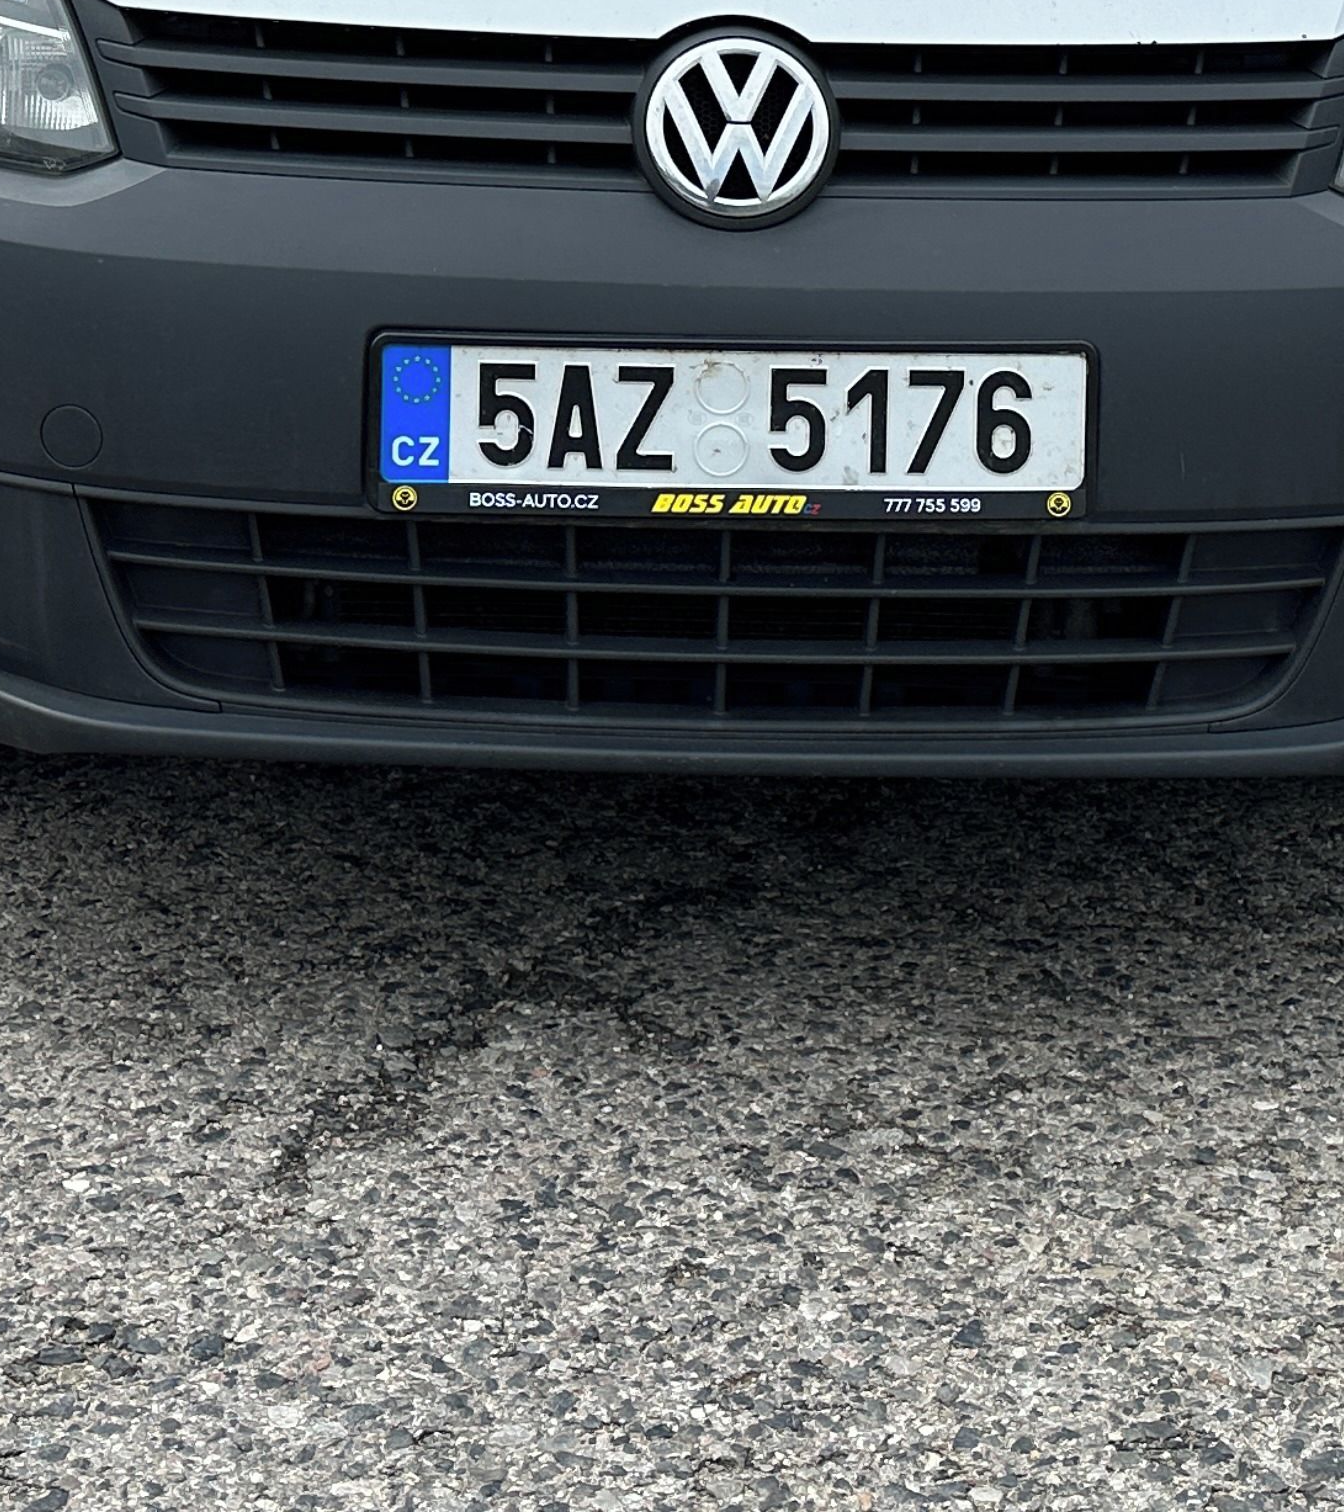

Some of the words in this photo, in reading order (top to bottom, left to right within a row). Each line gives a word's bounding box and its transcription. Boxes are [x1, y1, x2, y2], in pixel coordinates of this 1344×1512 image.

[477, 361, 677, 473] 5AZ
[767, 367, 1032, 476] 5176
[391, 435, 440, 467] CZ
[469, 492, 599, 509] BOSS-AUTO.CZ
[651, 493, 727, 515] BOSS
[884, 498, 915, 513] 777
[917, 499, 946, 514] 755
[948, 499, 981, 514] 599
